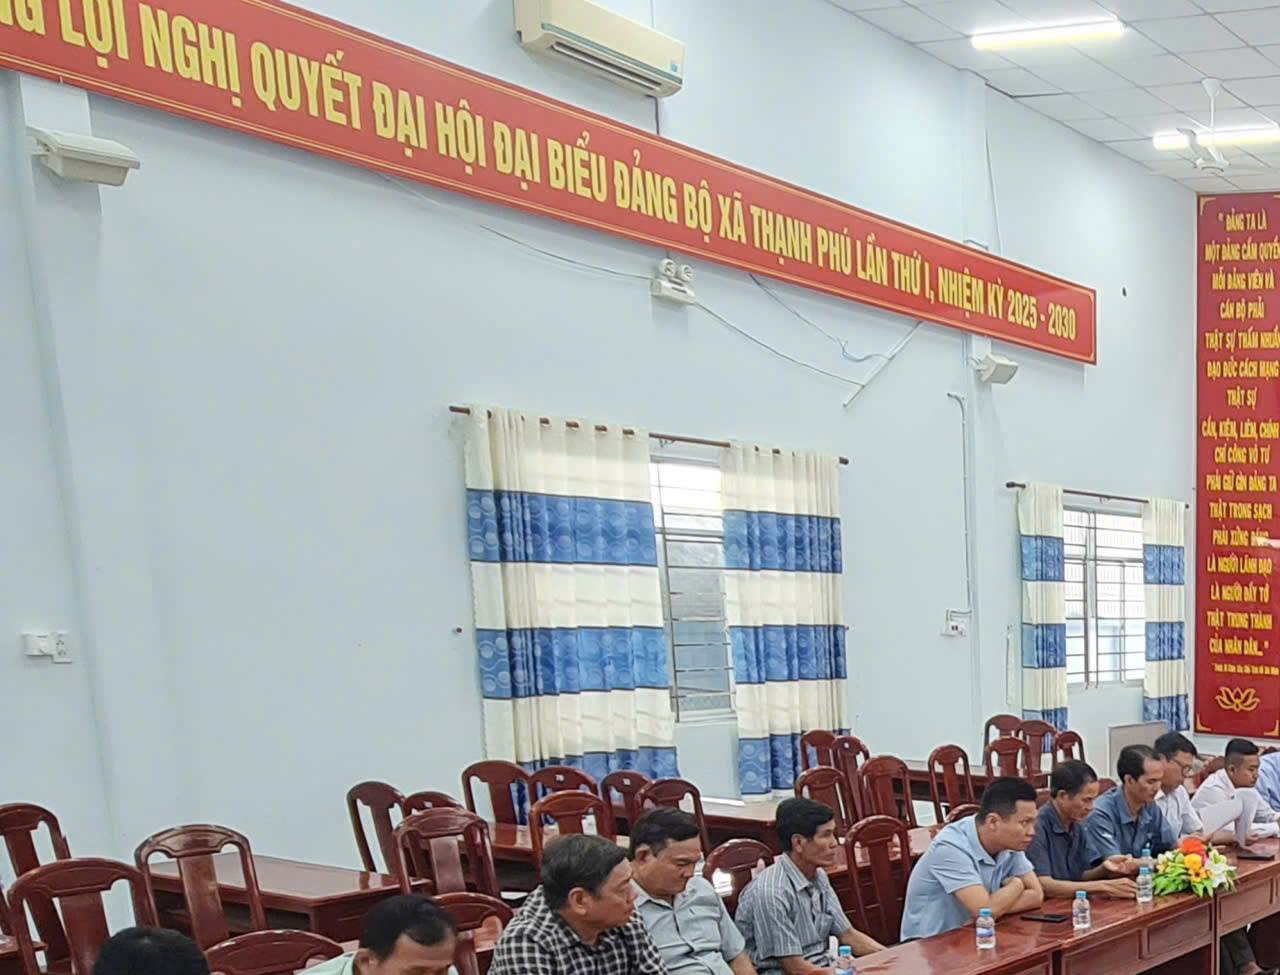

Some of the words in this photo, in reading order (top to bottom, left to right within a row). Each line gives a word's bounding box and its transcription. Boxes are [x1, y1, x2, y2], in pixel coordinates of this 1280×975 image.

[139, 8, 241, 107] NGHỊ
[251, 41, 362, 131] QUYẾT
[373, 80, 428, 157] ĐẠI
[434, 98, 487, 176] HỘI
[494, 124, 541, 191] ĐẠI
[547, 129, 608, 203] BIỂU
[613, 149, 678, 223] ĐẢNG
[683, 179, 713, 245] BỘ
[718, 191, 746, 244] XÃ
[750, 204, 813, 265] THẠNH
[817, 227, 852, 276] PHÚ
[855, 231, 889, 286] LẦN
[891, 249, 924, 295] THỨ
[938, 267, 985, 320] NHIỆM
[987, 276, 1007, 320] KỲ
[1007, 288, 1038, 330] 2025
[1047, 302, 1077, 341] 2030
[1246, 213, 1256, 230] TA
[1257, 208, 1267, 230] LÀ
